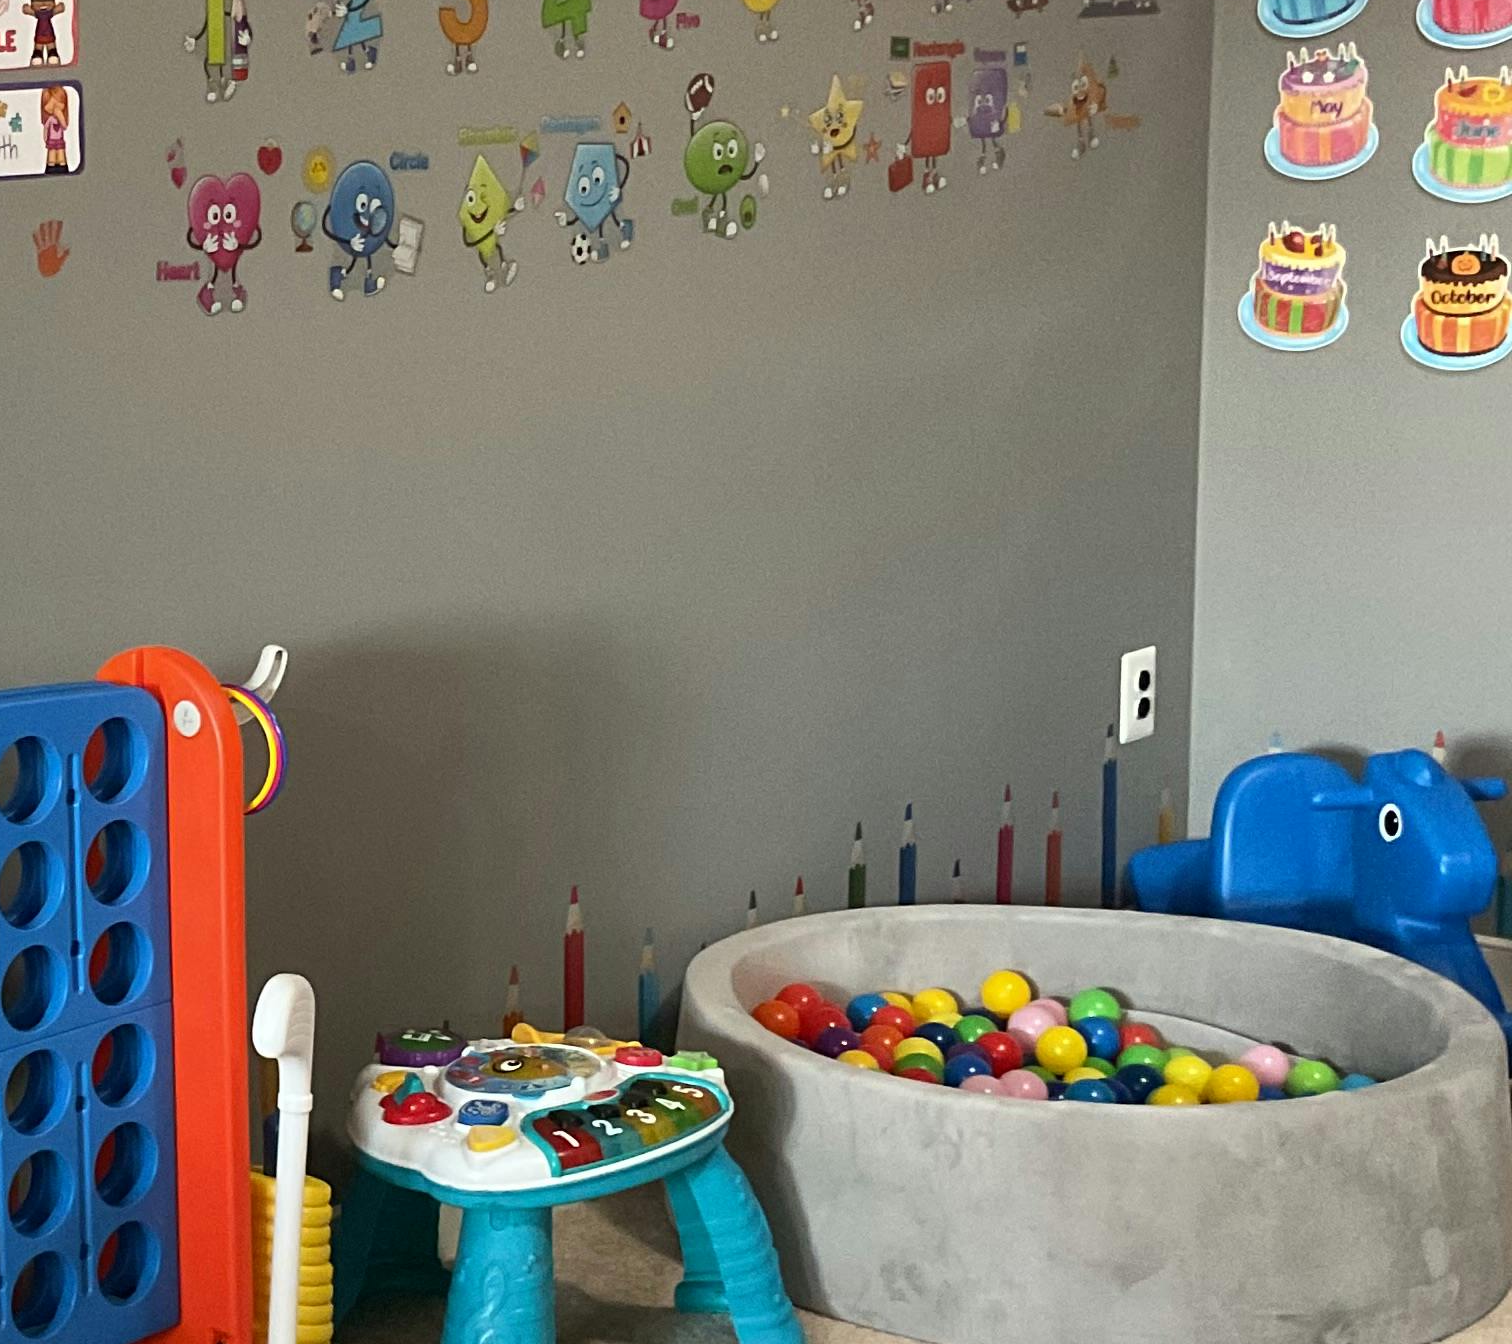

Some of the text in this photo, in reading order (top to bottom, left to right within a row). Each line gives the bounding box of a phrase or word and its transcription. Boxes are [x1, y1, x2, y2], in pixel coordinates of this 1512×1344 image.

[1310, 97, 1344, 119] May
[1430, 288, 1497, 307] October
[552, 1085, 704, 1147] 1 2 3 4 5
